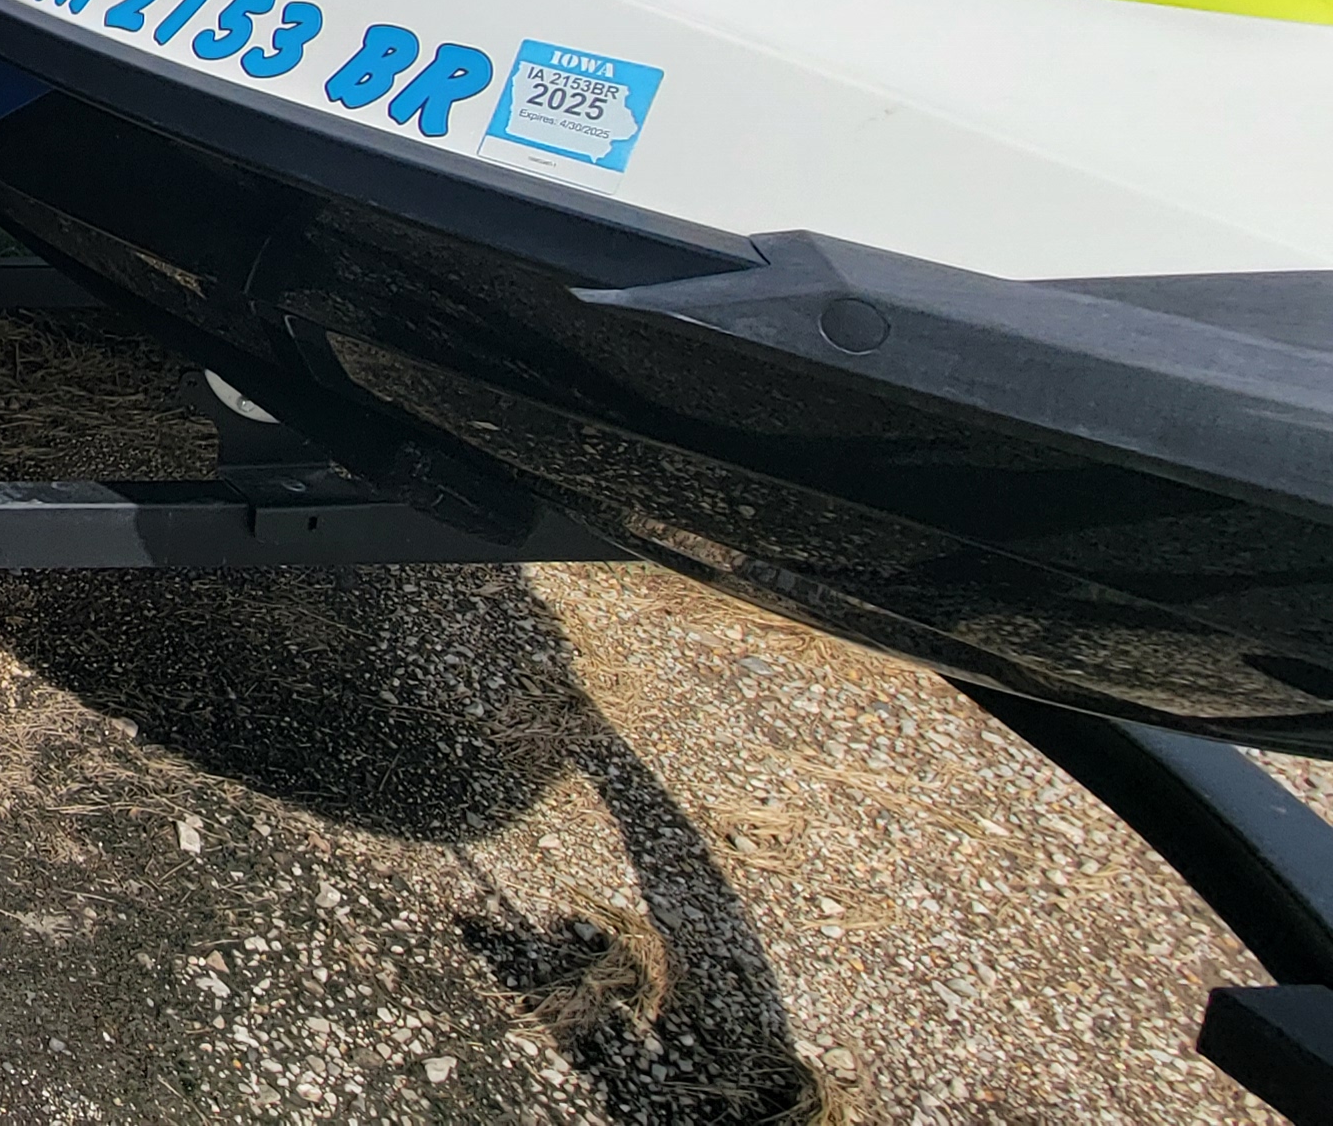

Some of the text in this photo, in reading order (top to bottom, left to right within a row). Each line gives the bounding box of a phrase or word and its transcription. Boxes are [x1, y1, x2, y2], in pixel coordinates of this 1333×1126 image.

[325, 23, 494, 137] BR
[550, 50, 615, 78] IOWA
[526, 66, 620, 100] IA 2153BR
[526, 83, 608, 121] 2025
[519, 109, 611, 139] Expires: 4/30/2025
